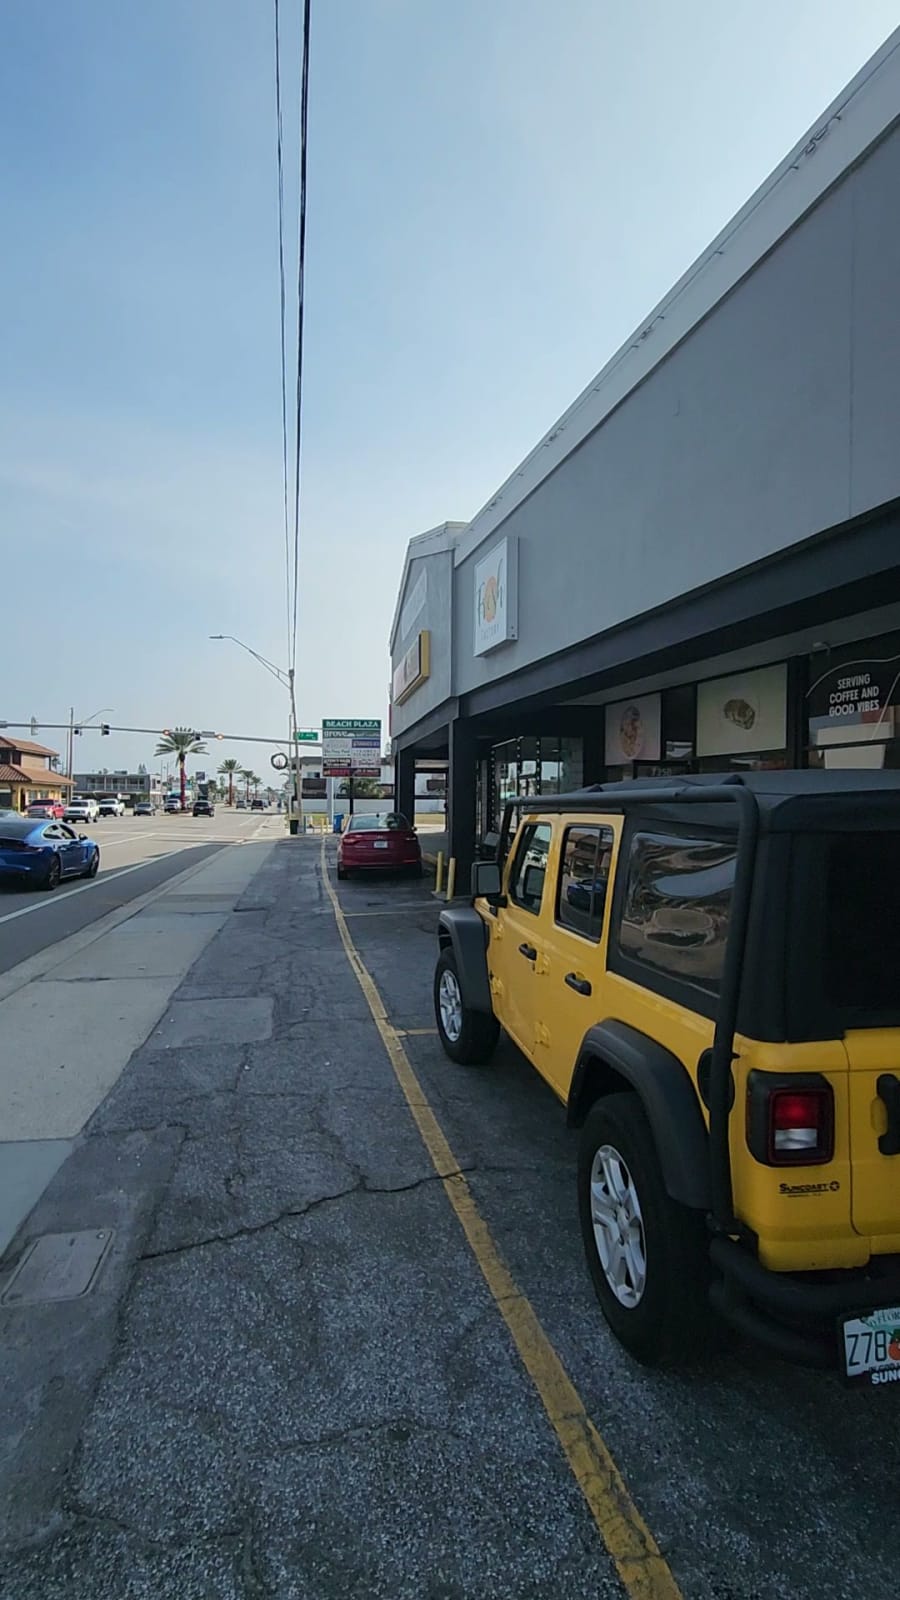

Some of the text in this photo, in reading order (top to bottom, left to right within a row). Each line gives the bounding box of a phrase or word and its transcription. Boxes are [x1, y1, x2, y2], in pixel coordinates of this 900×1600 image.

[838, 673, 871, 689] SERVING
[829, 685, 880, 704] COFFEE AND
[829, 699, 880, 718] GOOD VIBES
[326, 720, 378, 728] BEACH PLAZA
[846, 1330, 887, 1367] Z78
